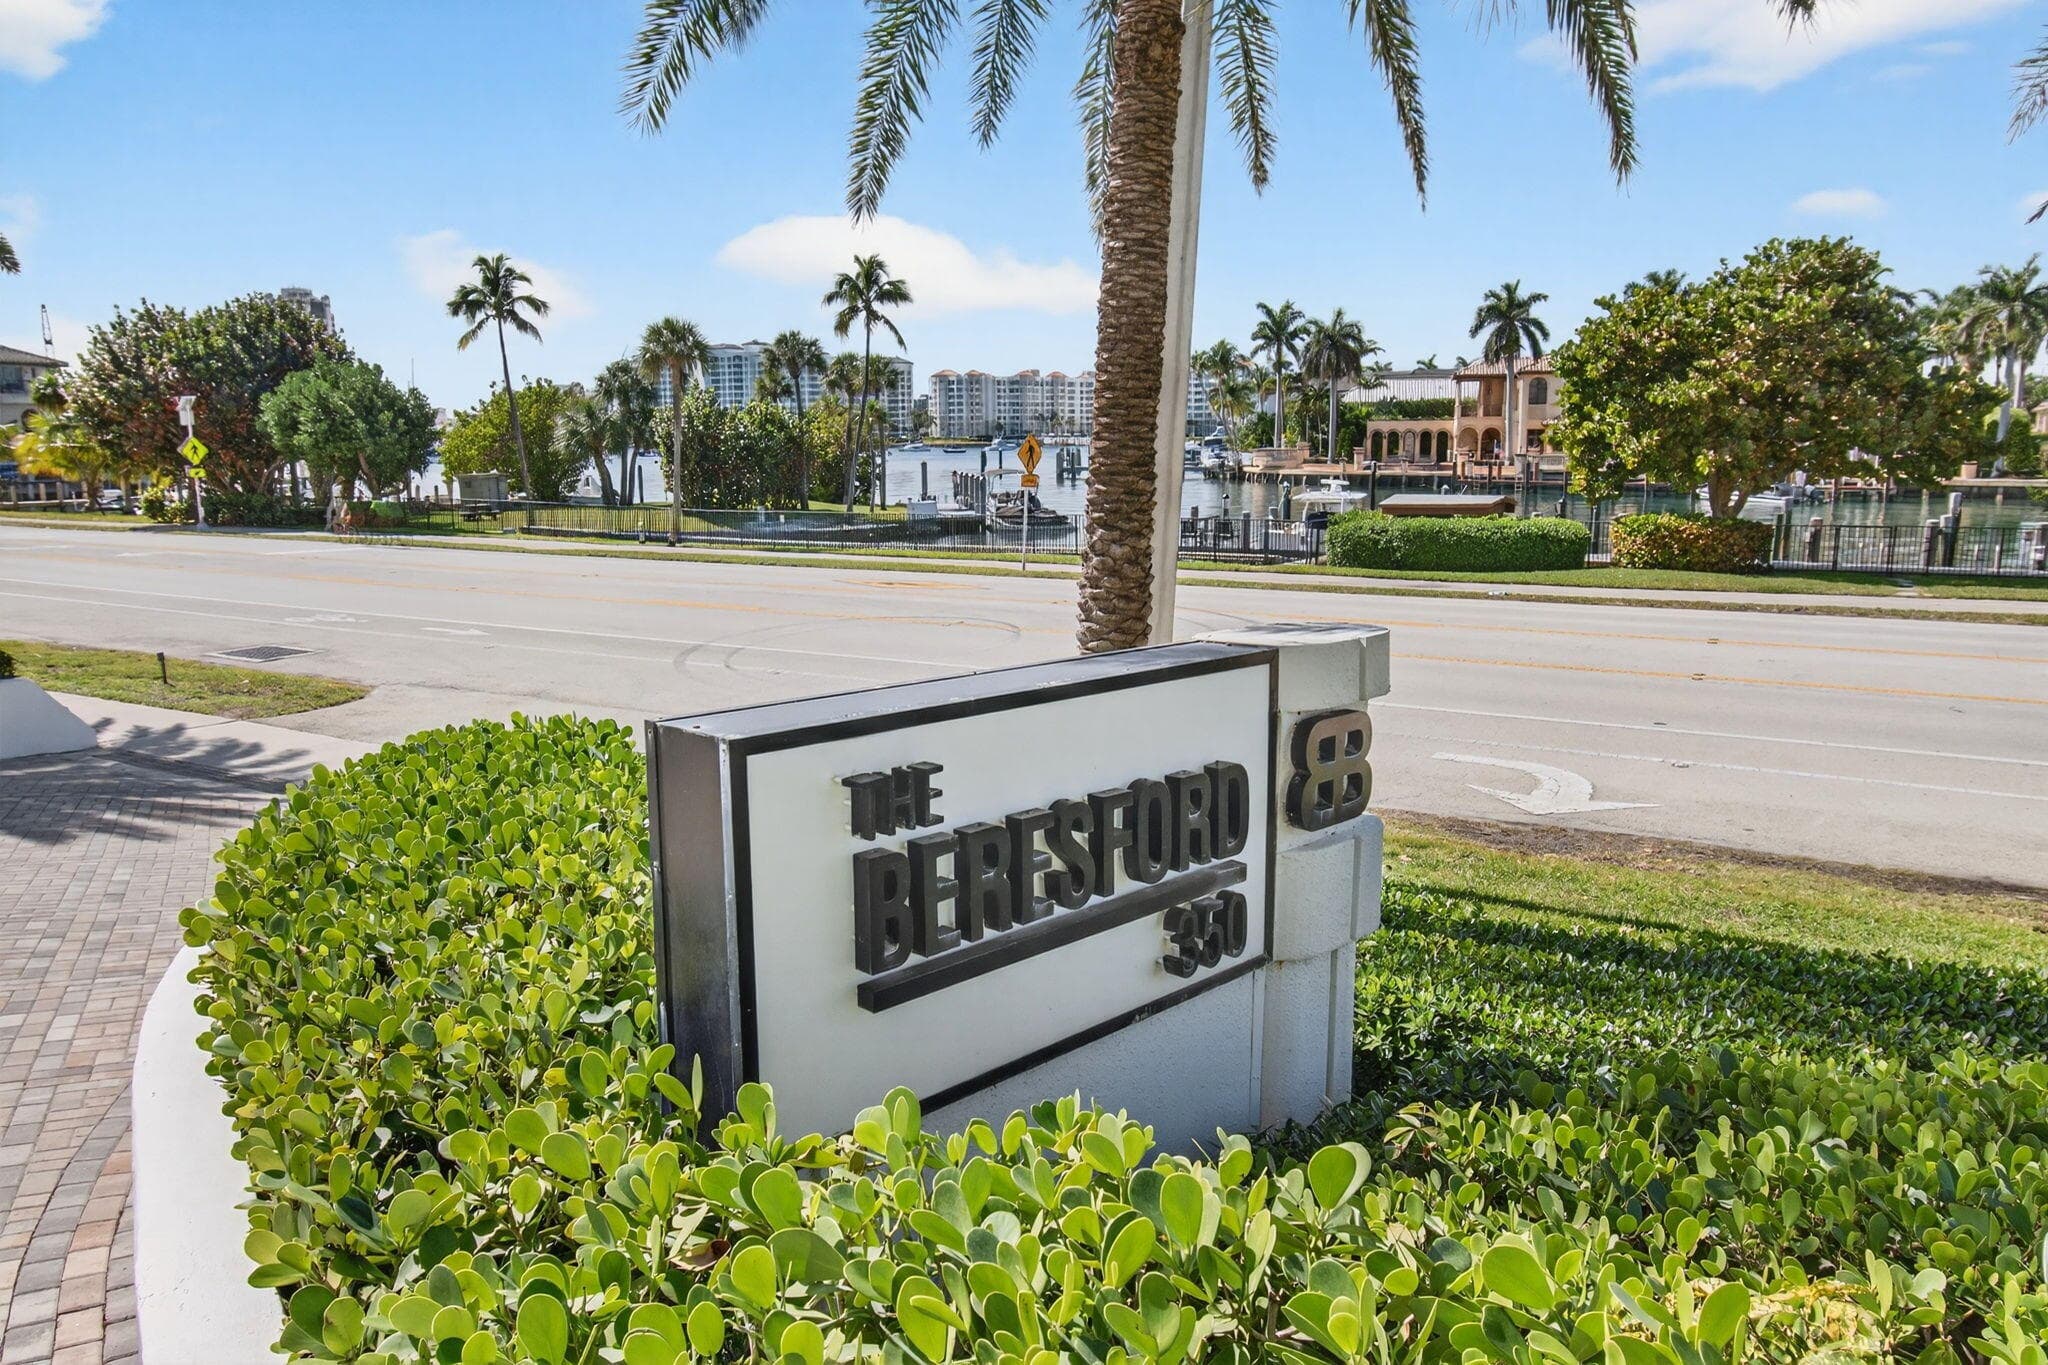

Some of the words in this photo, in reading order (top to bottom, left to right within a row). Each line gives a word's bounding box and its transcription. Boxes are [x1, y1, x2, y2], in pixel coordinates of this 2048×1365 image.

[842, 761, 944, 841] THE
[853, 760, 1250, 975] BERESFORD
[1163, 889, 1249, 978] 350
